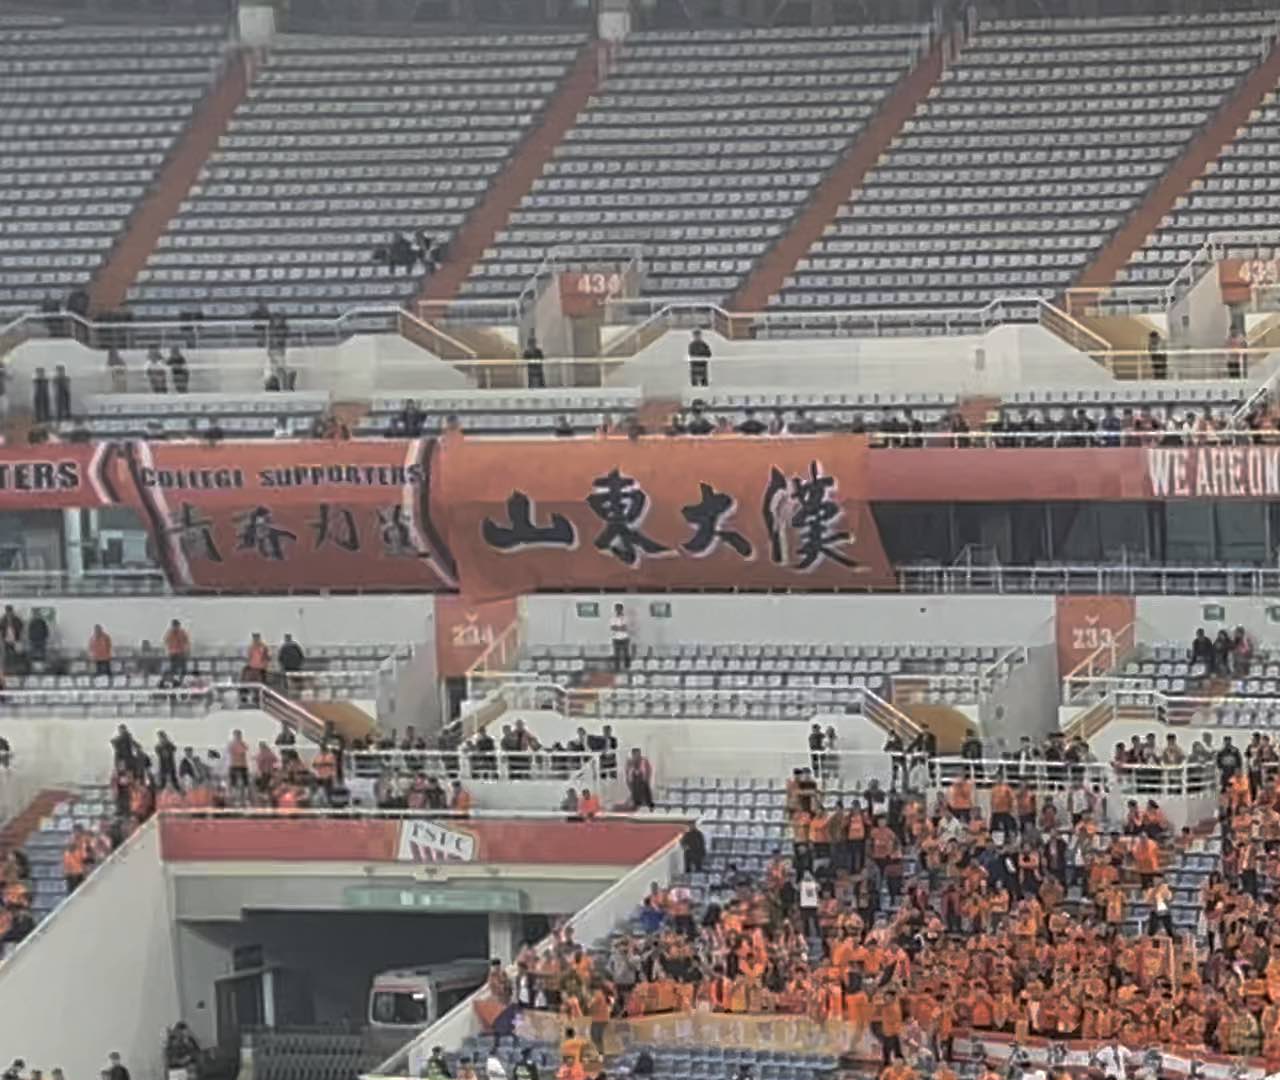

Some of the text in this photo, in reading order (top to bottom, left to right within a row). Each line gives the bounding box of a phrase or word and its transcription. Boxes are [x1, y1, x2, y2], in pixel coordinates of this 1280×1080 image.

[1148, 448, 1190, 496] WE
[1196, 448, 1246, 496] ARE
[481, 460, 872, 572] 山東大漢
